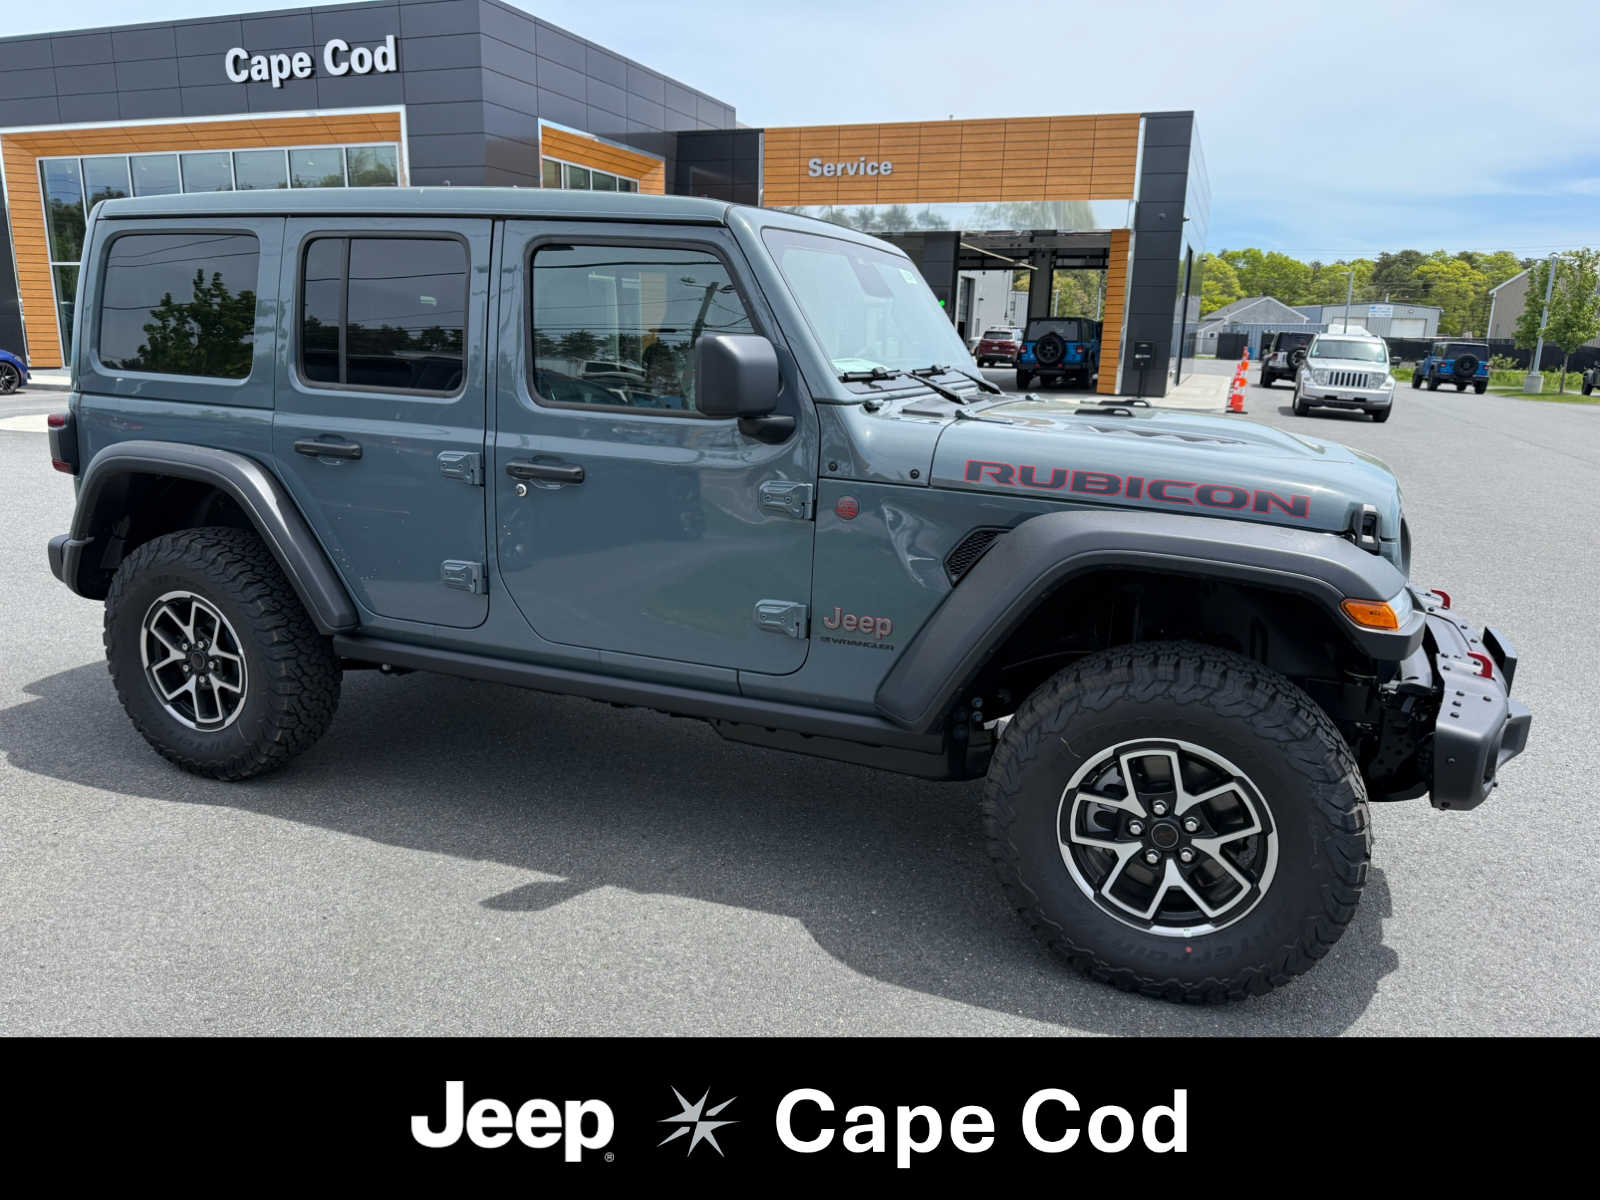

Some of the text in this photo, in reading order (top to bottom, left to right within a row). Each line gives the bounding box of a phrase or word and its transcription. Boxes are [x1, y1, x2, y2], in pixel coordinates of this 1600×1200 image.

[225, 34, 397, 88] Cape Cod
[808, 156, 893, 177] Service
[963, 460, 1312, 519] RUBICON
[823, 607, 893, 640] Jeep
